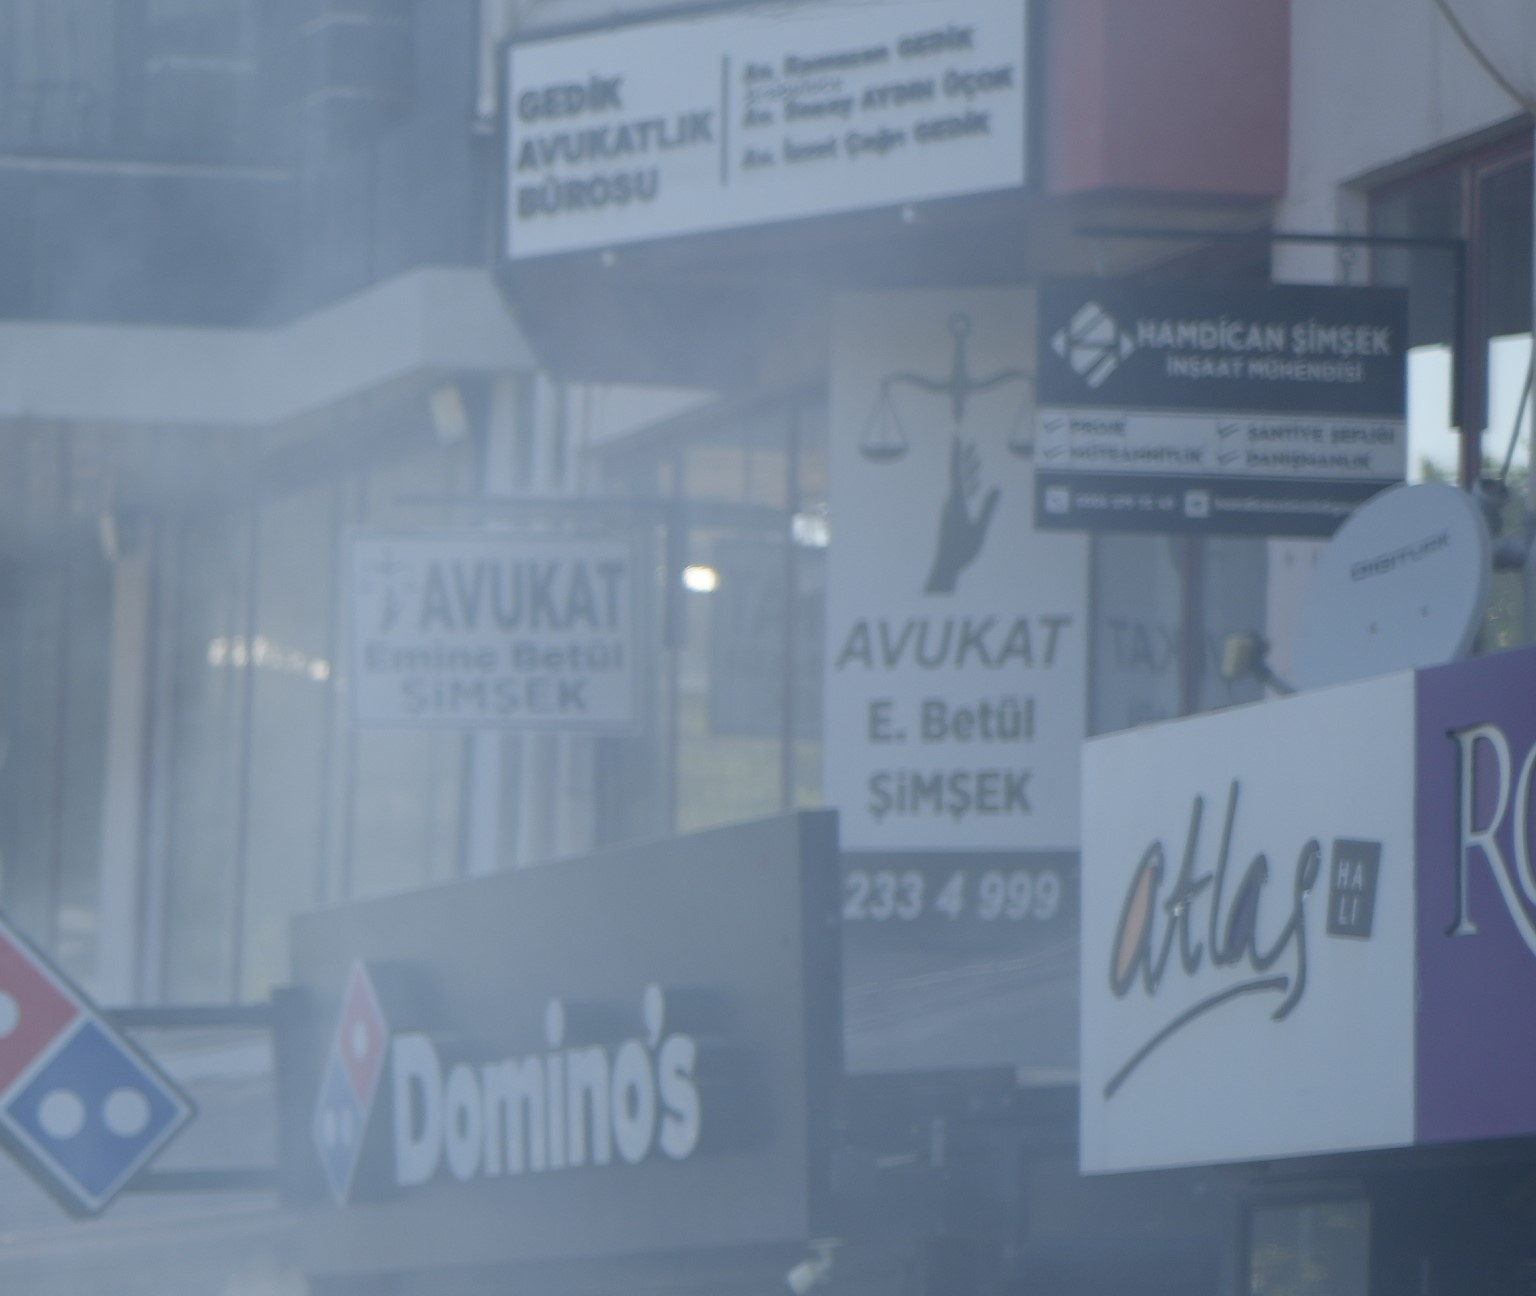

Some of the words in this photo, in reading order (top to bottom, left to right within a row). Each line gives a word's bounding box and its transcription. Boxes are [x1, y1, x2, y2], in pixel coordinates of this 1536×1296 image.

[519, 72, 625, 122] GEDİK
[518, 107, 714, 173] AVUKATLIK
[518, 165, 658, 219] BÜROSU
[1136, 315, 1285, 351] HAMDİCAN
[1291, 318, 1392, 357] ŞİMŞEK
[1167, 355, 1243, 380] İNŞAAT
[1248, 356, 1365, 383] MÜHENDİSİ
[419, 559, 626, 633] AVUKAT
[834, 613, 1073, 672] AVUKAT
[868, 699, 907, 745] E.
[920, 696, 1036, 745] Betül
[843, 868, 924, 921] 233
[935, 868, 965, 921] 4
[979, 868, 1061, 921] 999
[392, 982, 701, 1187] Domino's
